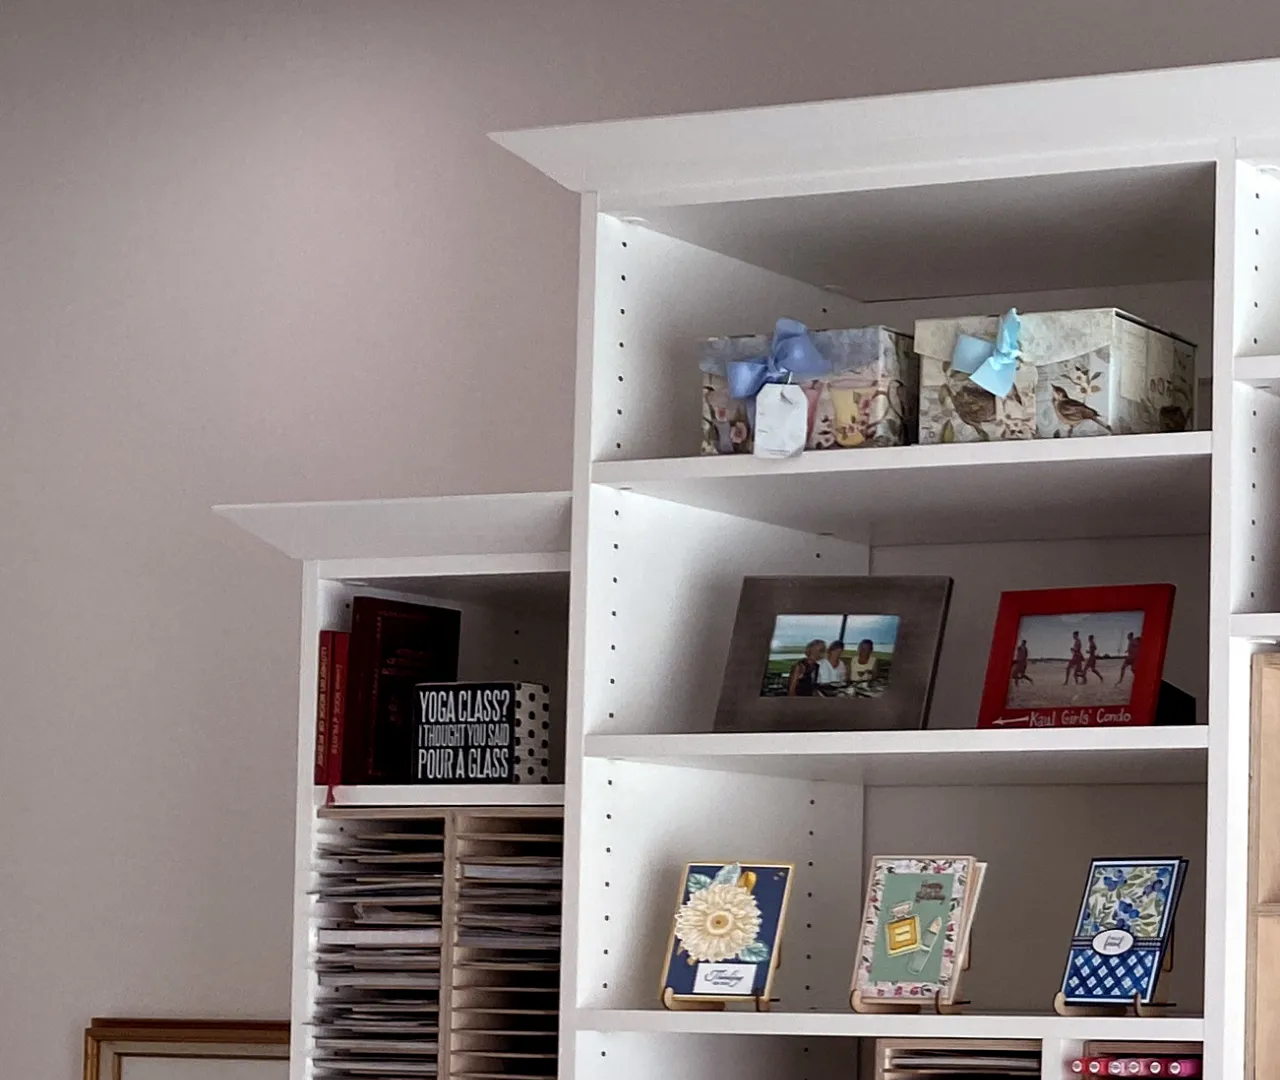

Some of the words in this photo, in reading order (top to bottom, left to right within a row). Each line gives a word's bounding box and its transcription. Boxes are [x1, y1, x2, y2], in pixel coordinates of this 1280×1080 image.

[419, 690, 456, 722] YOGA
[459, 690, 510, 722] CLASS?
[1061, 709, 1092, 724] Girls'
[1096, 707, 1131, 723] Condo
[418, 725, 422, 747] I
[423, 724, 466, 747] THOUGHT
[467, 723, 486, 746] YOU
[488, 723, 509, 746] SAID
[418, 749, 453, 779] POUR
[456, 748, 465, 778] A
[468, 748, 508, 778] GLASS
